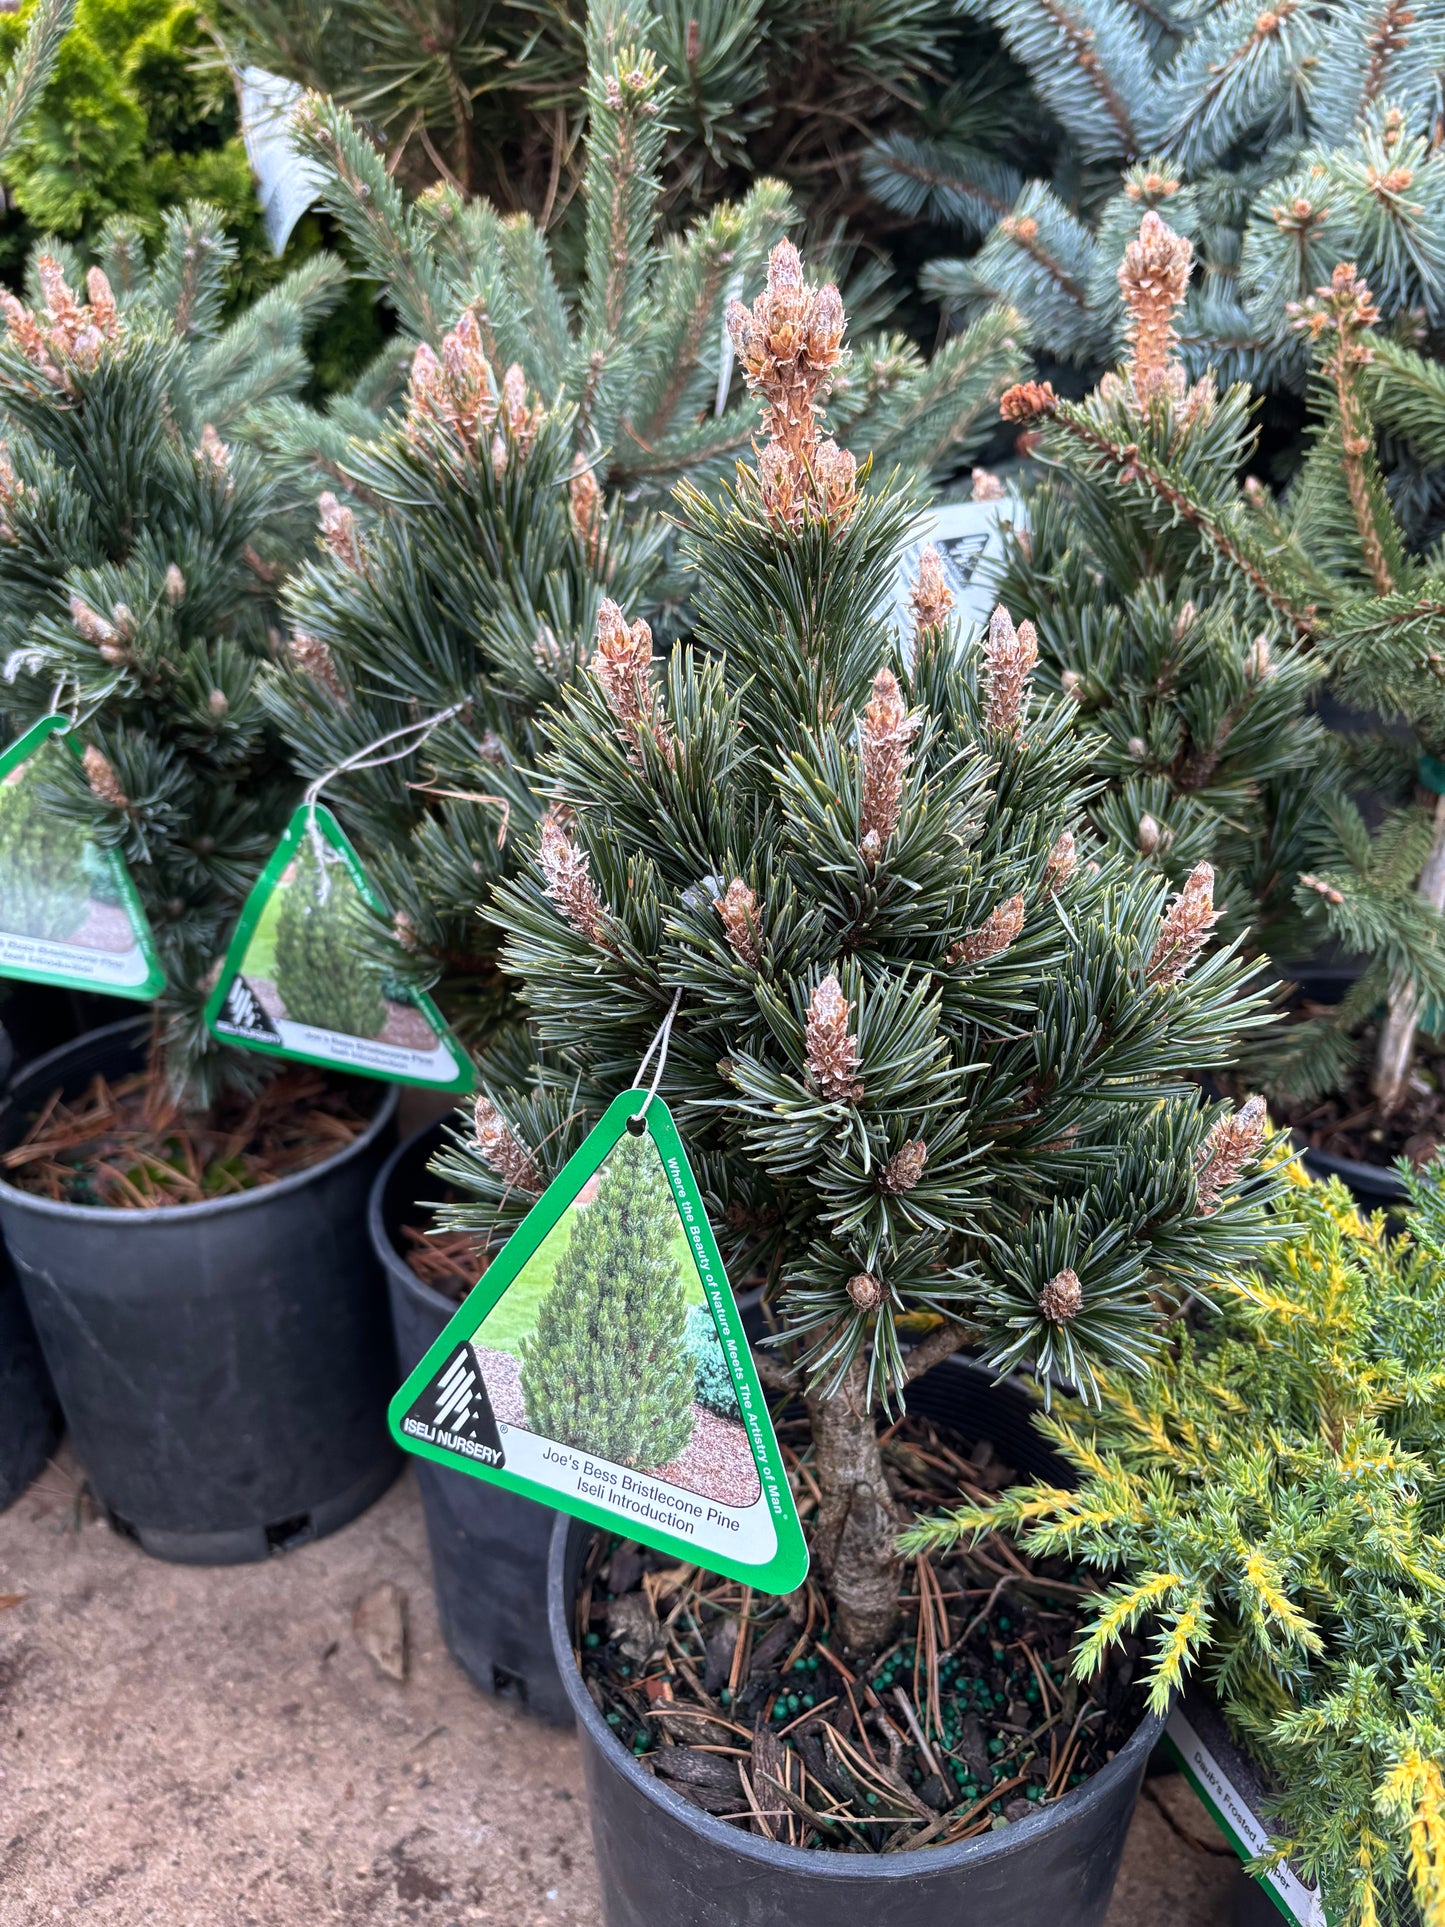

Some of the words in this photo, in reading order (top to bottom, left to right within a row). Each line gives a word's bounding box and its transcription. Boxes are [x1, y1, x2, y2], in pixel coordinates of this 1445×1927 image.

[667, 1157, 687, 1198] Where
[681, 1201, 694, 1222] the
[689, 1225, 711, 1271] Beauty
[705, 1274, 718, 1288] of
[711, 1290, 731, 1336] Nature
[725, 1339, 744, 1380] Meets
[739, 1383, 752, 1409] The
[403, 1417, 437, 1442] ISELI
[436, 1429, 503, 1466] NURSERY
[747, 1412, 769, 1463] Artistry
[542, 1446, 580, 1470] Joe's
[583, 1460, 617, 1485] Bess
[621, 1475, 702, 1517] Bristlecone
[706, 1507, 741, 1532] Pine
[763, 1467, 776, 1481] of
[576, 1476, 604, 1499] Iseli
[608, 1488, 695, 1535] Introduction
[1193, 1751, 1222, 1796] Daub's
[1223, 1793, 1257, 1843] Frosted
